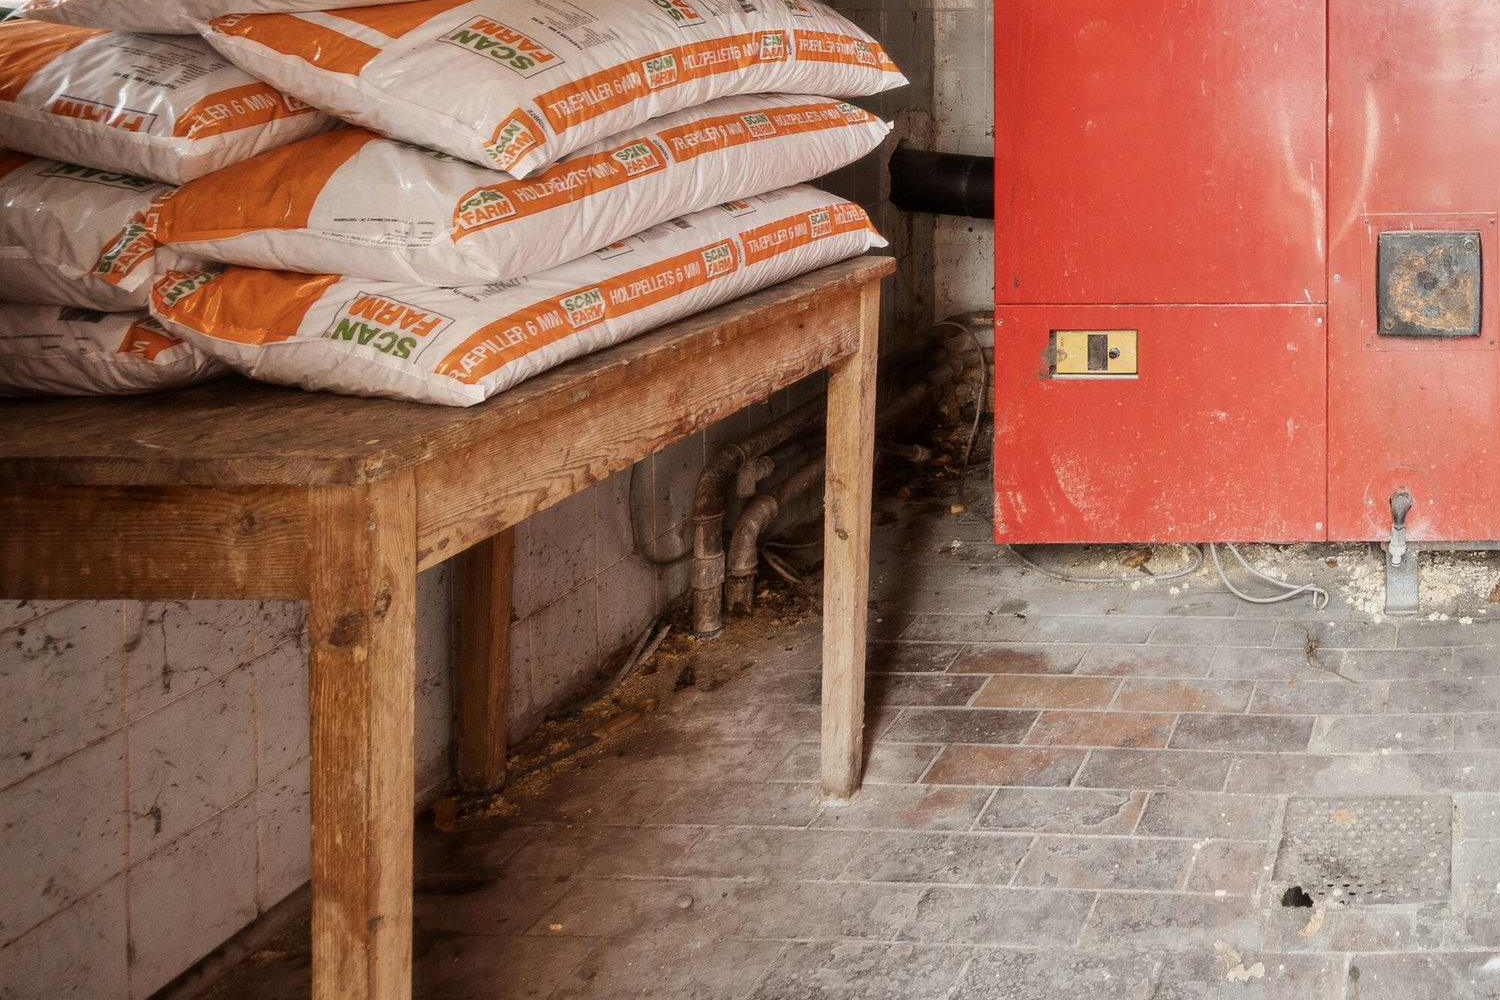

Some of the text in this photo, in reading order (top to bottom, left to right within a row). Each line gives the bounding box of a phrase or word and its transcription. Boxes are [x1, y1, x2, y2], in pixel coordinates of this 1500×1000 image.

[449, 29, 535, 70] SCAN
[470, 19, 556, 64] FARM
[646, 55, 674, 73] SCAN
[650, 68, 676, 87] FARM
[231, 100, 246, 115] 6
[242, 93, 277, 111] MM
[548, 82, 614, 119] TRÆPILLER
[614, 79, 625, 96] 6
[744, 114, 769, 125] SCAN
[615, 143, 651, 160] SCAN
[626, 155, 660, 174] FARM
[460, 202, 512, 226] FARM
[811, 212, 830, 225] SCAN
[747, 228, 788, 253] TRÆPILLER
[704, 244, 730, 263] SCAN
[707, 257, 733, 276] FARM
[609, 261, 701, 305] HOLZPELLETS 6 MM
[564, 290, 601, 311] SCAN
[348, 295, 443, 338] FARM
[570, 304, 602, 324] FARM
[331, 317, 417, 360] SCAN
[448, 310, 563, 385] RÆPILLER 6 MM
